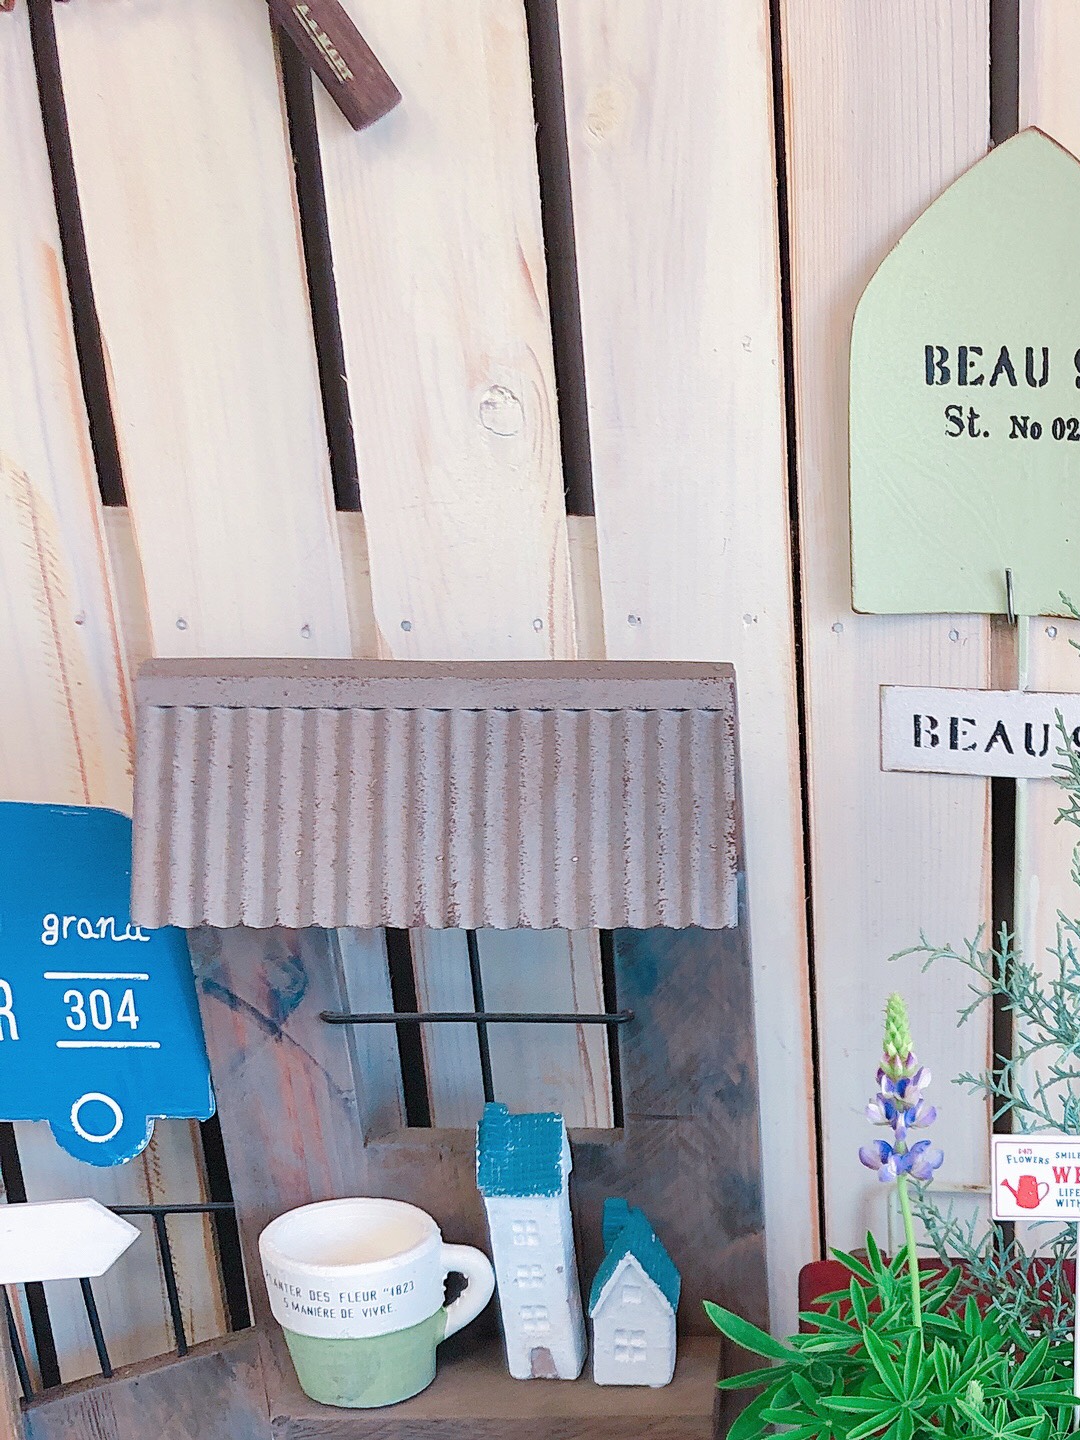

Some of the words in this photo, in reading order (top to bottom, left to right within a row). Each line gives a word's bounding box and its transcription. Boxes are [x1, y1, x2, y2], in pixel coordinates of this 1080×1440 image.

[925, 345, 1049, 387] BEAU
[944, 405, 990, 438] St.
[1009, 415, 1042, 440] No
[913, 714, 1049, 757] BEAU
[63, 989, 140, 1031] 304
[1059, 1188, 1080, 1197] LIFE
[310, 1289, 331, 1302] DES
[339, 1290, 377, 1303] FLEUR
[341, 1308, 354, 1319] DE
